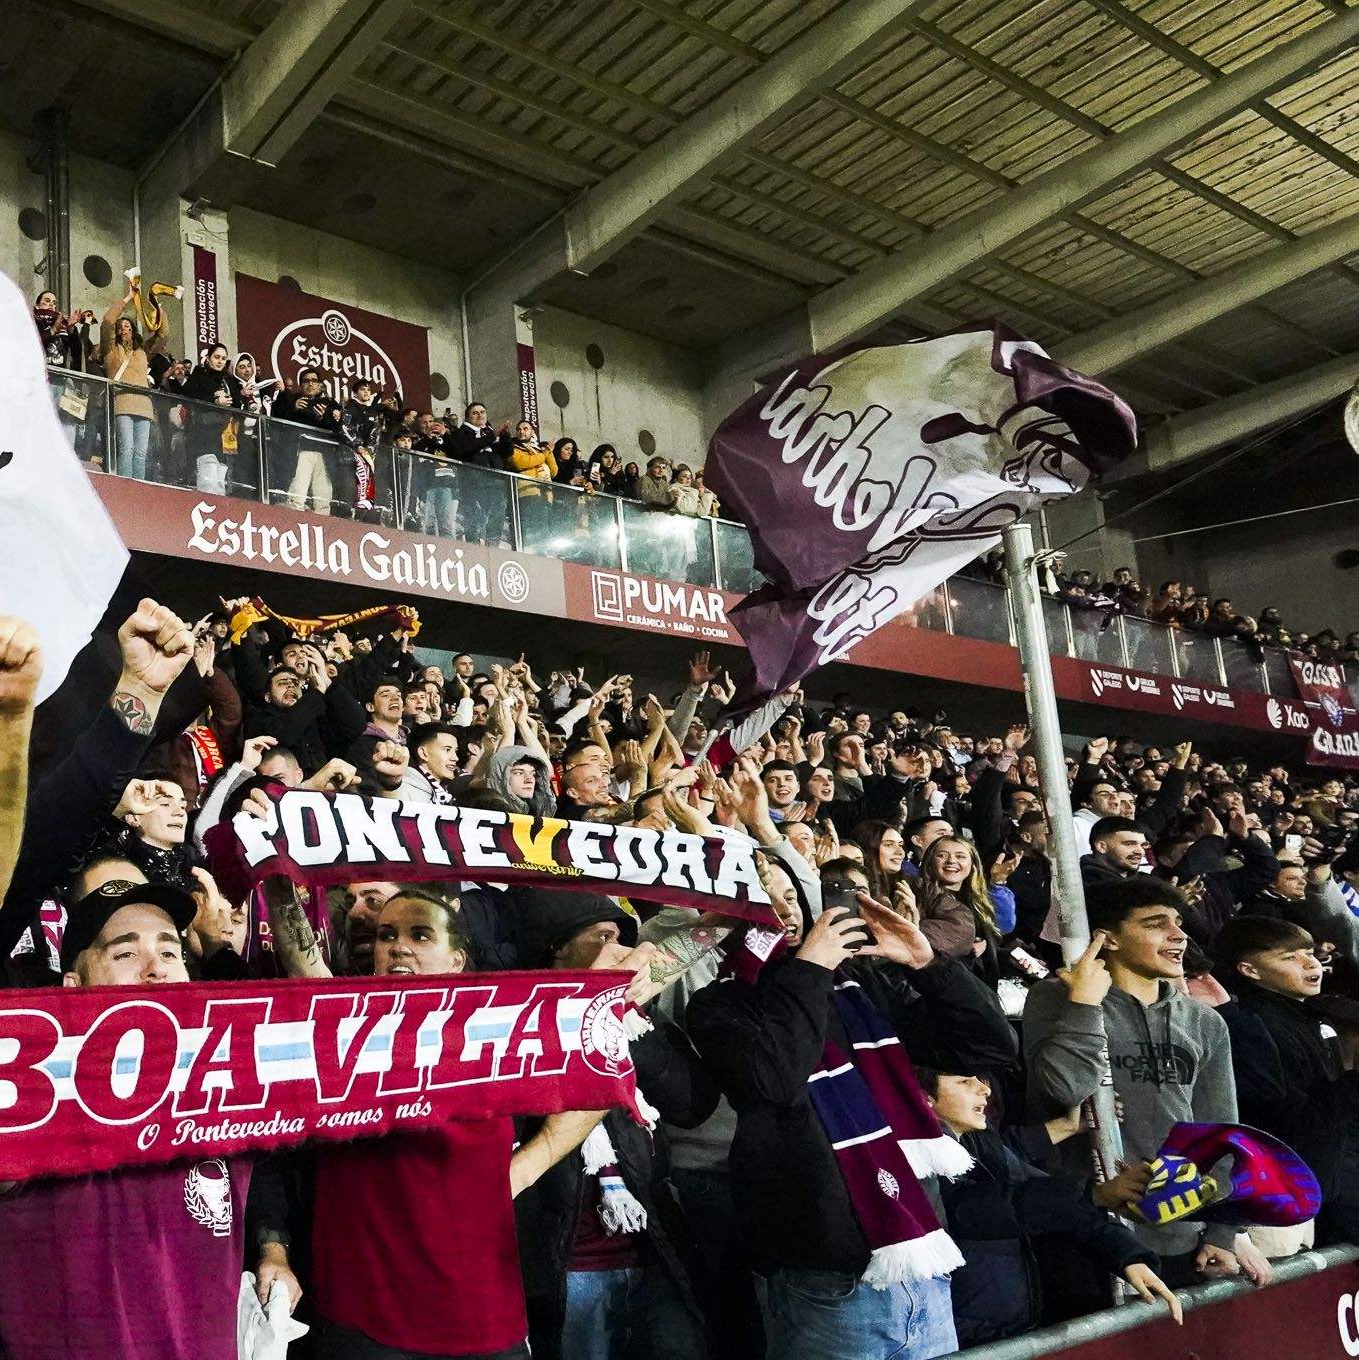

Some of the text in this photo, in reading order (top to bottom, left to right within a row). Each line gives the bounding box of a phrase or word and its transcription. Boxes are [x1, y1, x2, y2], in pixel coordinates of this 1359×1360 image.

[196, 279, 208, 343] Deputación
[207, 281, 216, 345] Pontevedra
[291, 334, 388, 386] Estrella
[188, 500, 490, 598] Estrella Galicia
[623, 576, 728, 624] PUMAR
[627, 614, 729, 638] CERÁMICA BAÑO COCINA
[232, 790, 772, 905] PONTEVEDRA
[137, 1095, 432, 1151] O Pontevedra somos nós
